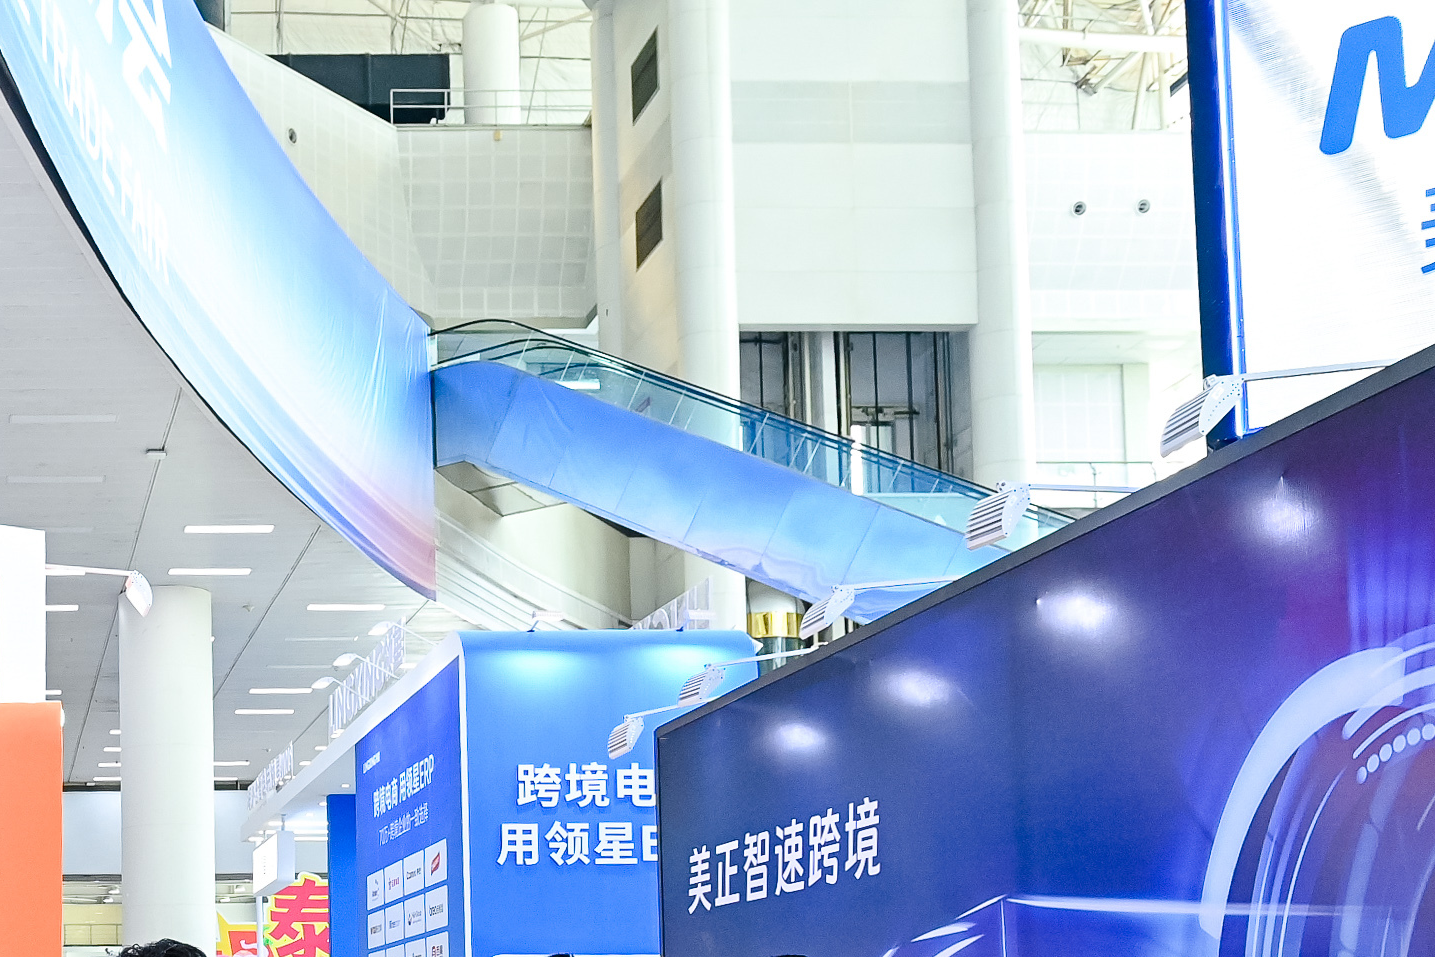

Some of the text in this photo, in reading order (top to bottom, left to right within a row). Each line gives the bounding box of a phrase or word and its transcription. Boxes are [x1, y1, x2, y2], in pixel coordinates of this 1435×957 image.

[516, 762, 657, 808] 跨境电
[687, 796, 882, 915] 美正智速跨境
